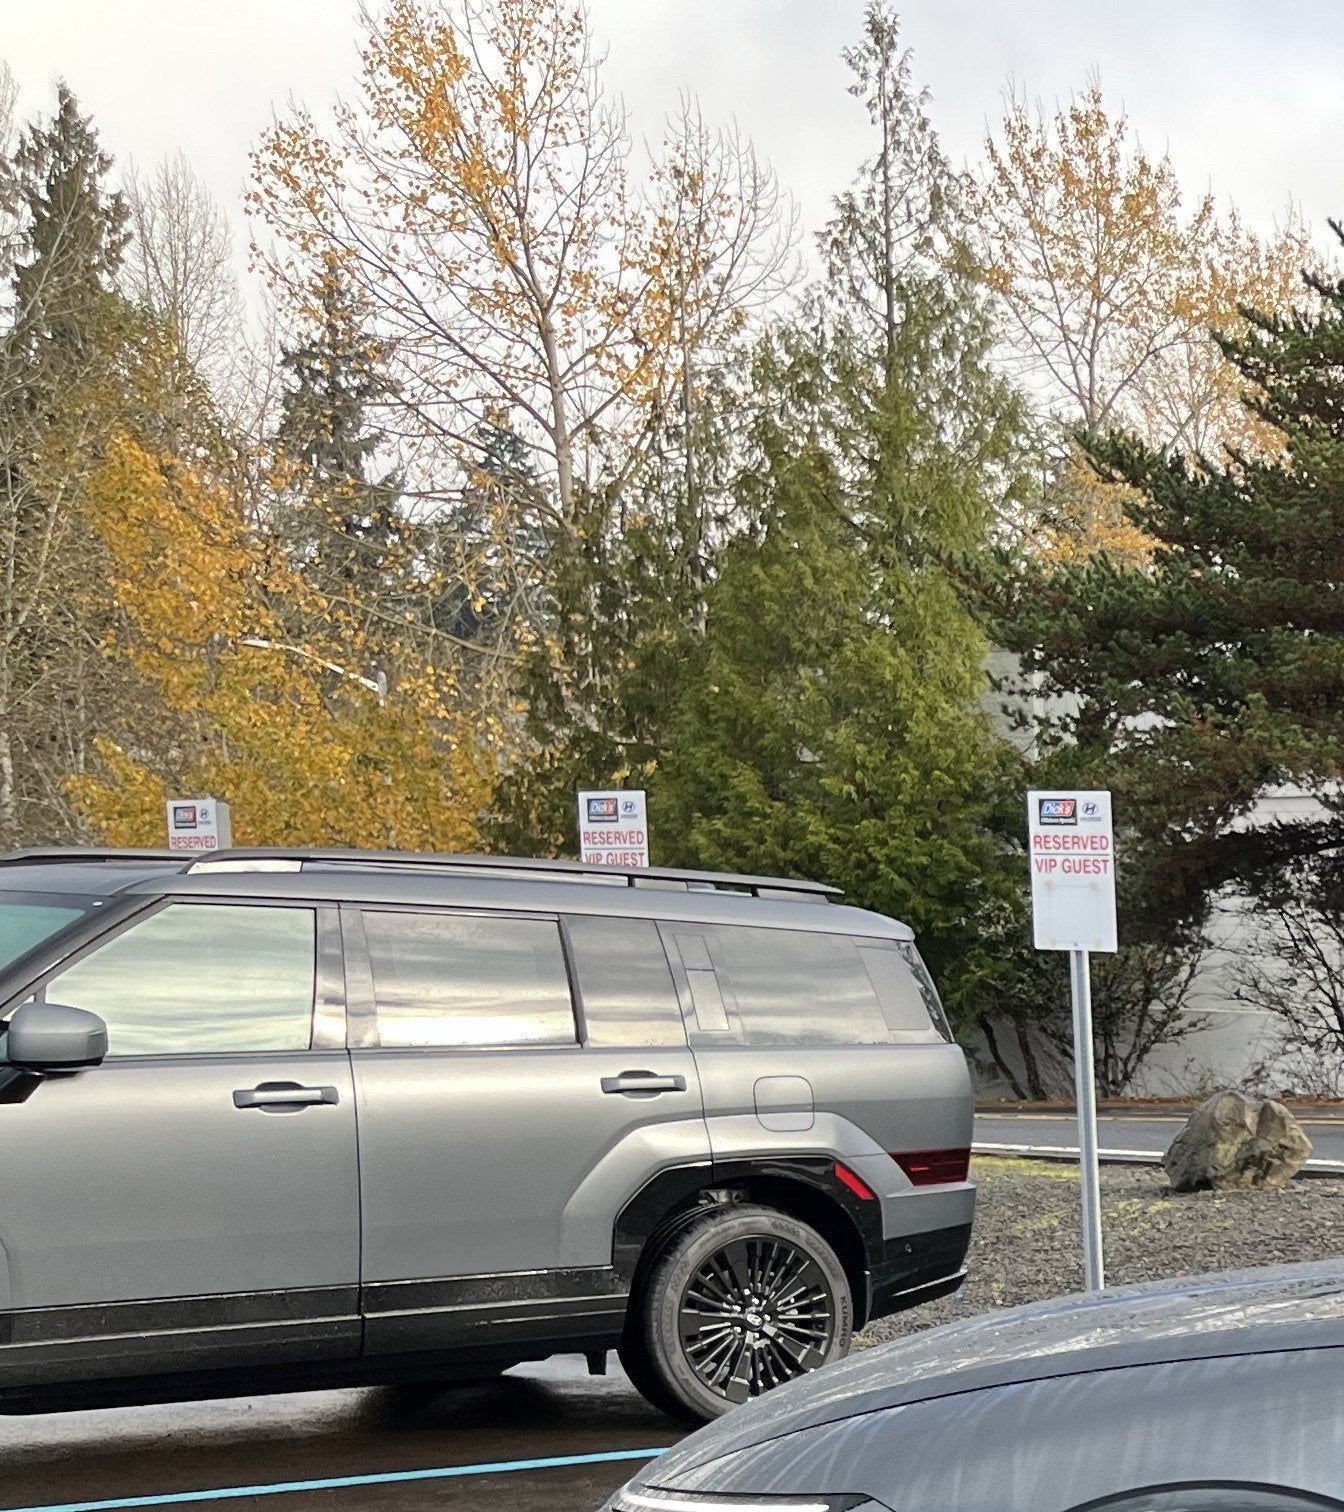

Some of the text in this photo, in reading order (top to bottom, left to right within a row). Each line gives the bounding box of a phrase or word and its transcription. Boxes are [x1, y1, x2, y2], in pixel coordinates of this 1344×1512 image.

[171, 835, 216, 849] RESERVED
[583, 830, 645, 845] RESERVED
[1033, 834, 1109, 851] RESERVED
[584, 852, 645, 867] VIP GUEST
[1035, 858, 1110, 875] VIP GUEST
[838, 1295, 848, 1349] KUMHO
